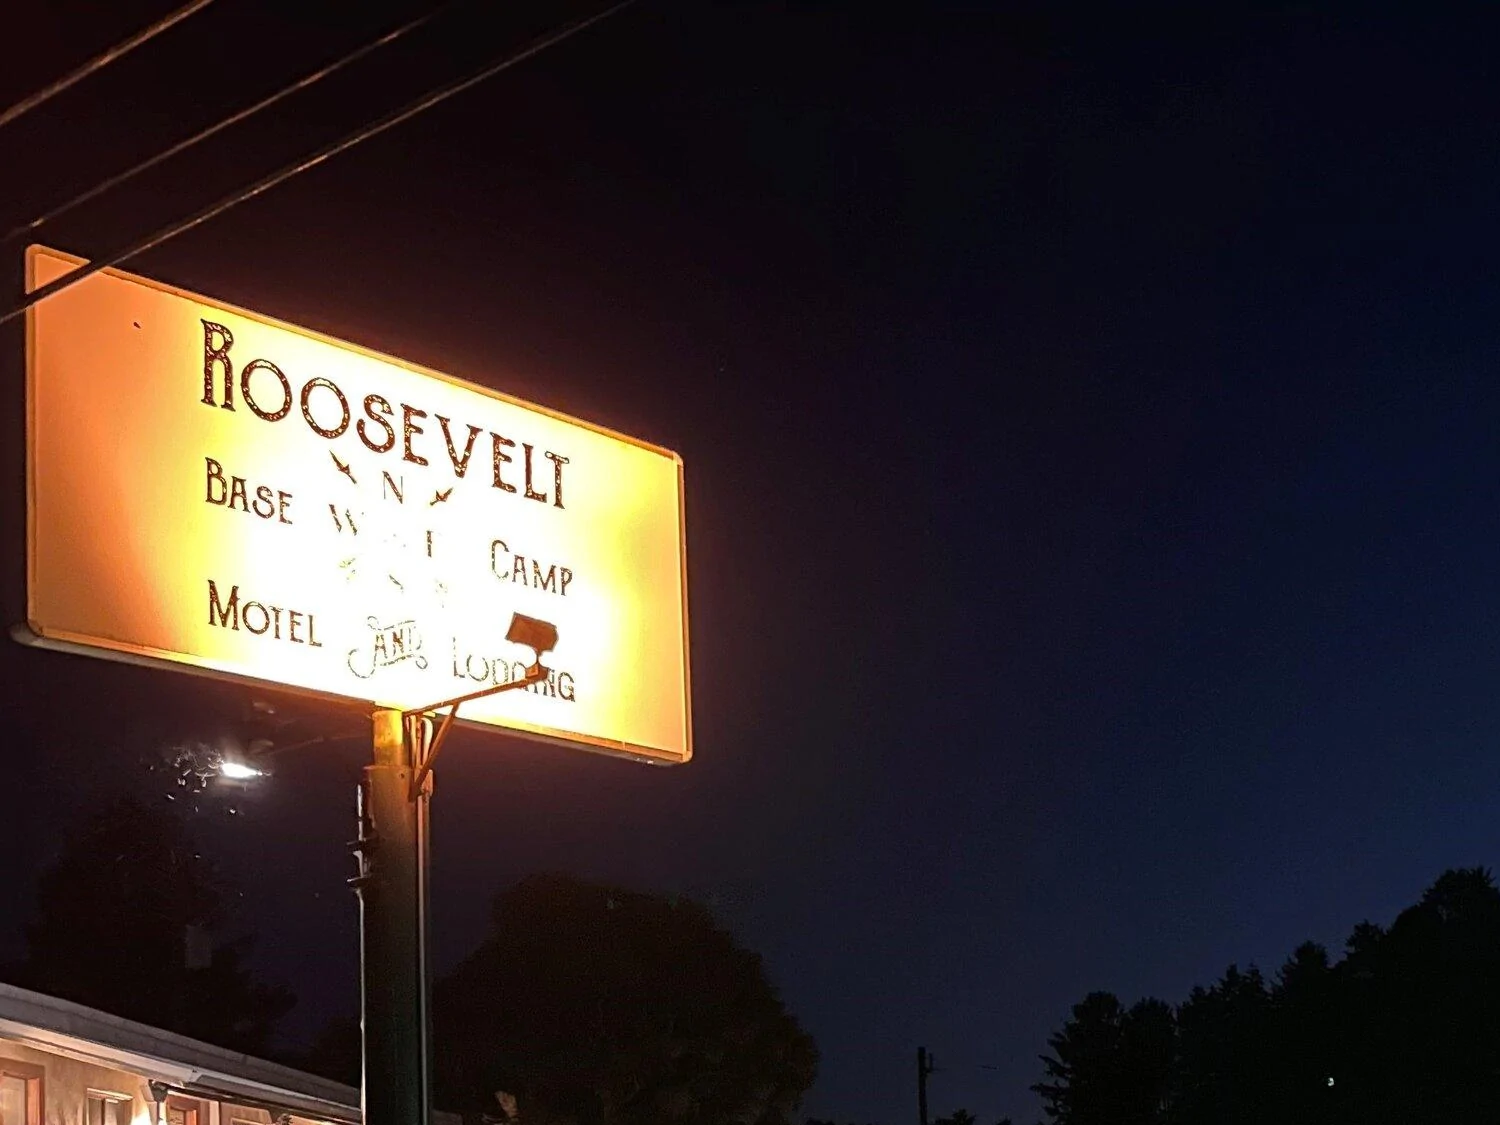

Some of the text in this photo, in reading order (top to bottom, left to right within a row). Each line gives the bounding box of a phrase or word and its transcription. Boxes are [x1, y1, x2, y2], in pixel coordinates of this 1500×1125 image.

[200, 318, 570, 510] ROOSEVELT
[204, 456, 294, 525] BASE
[490, 539, 573, 596] CAMP
[207, 578, 323, 648] MOTEL
